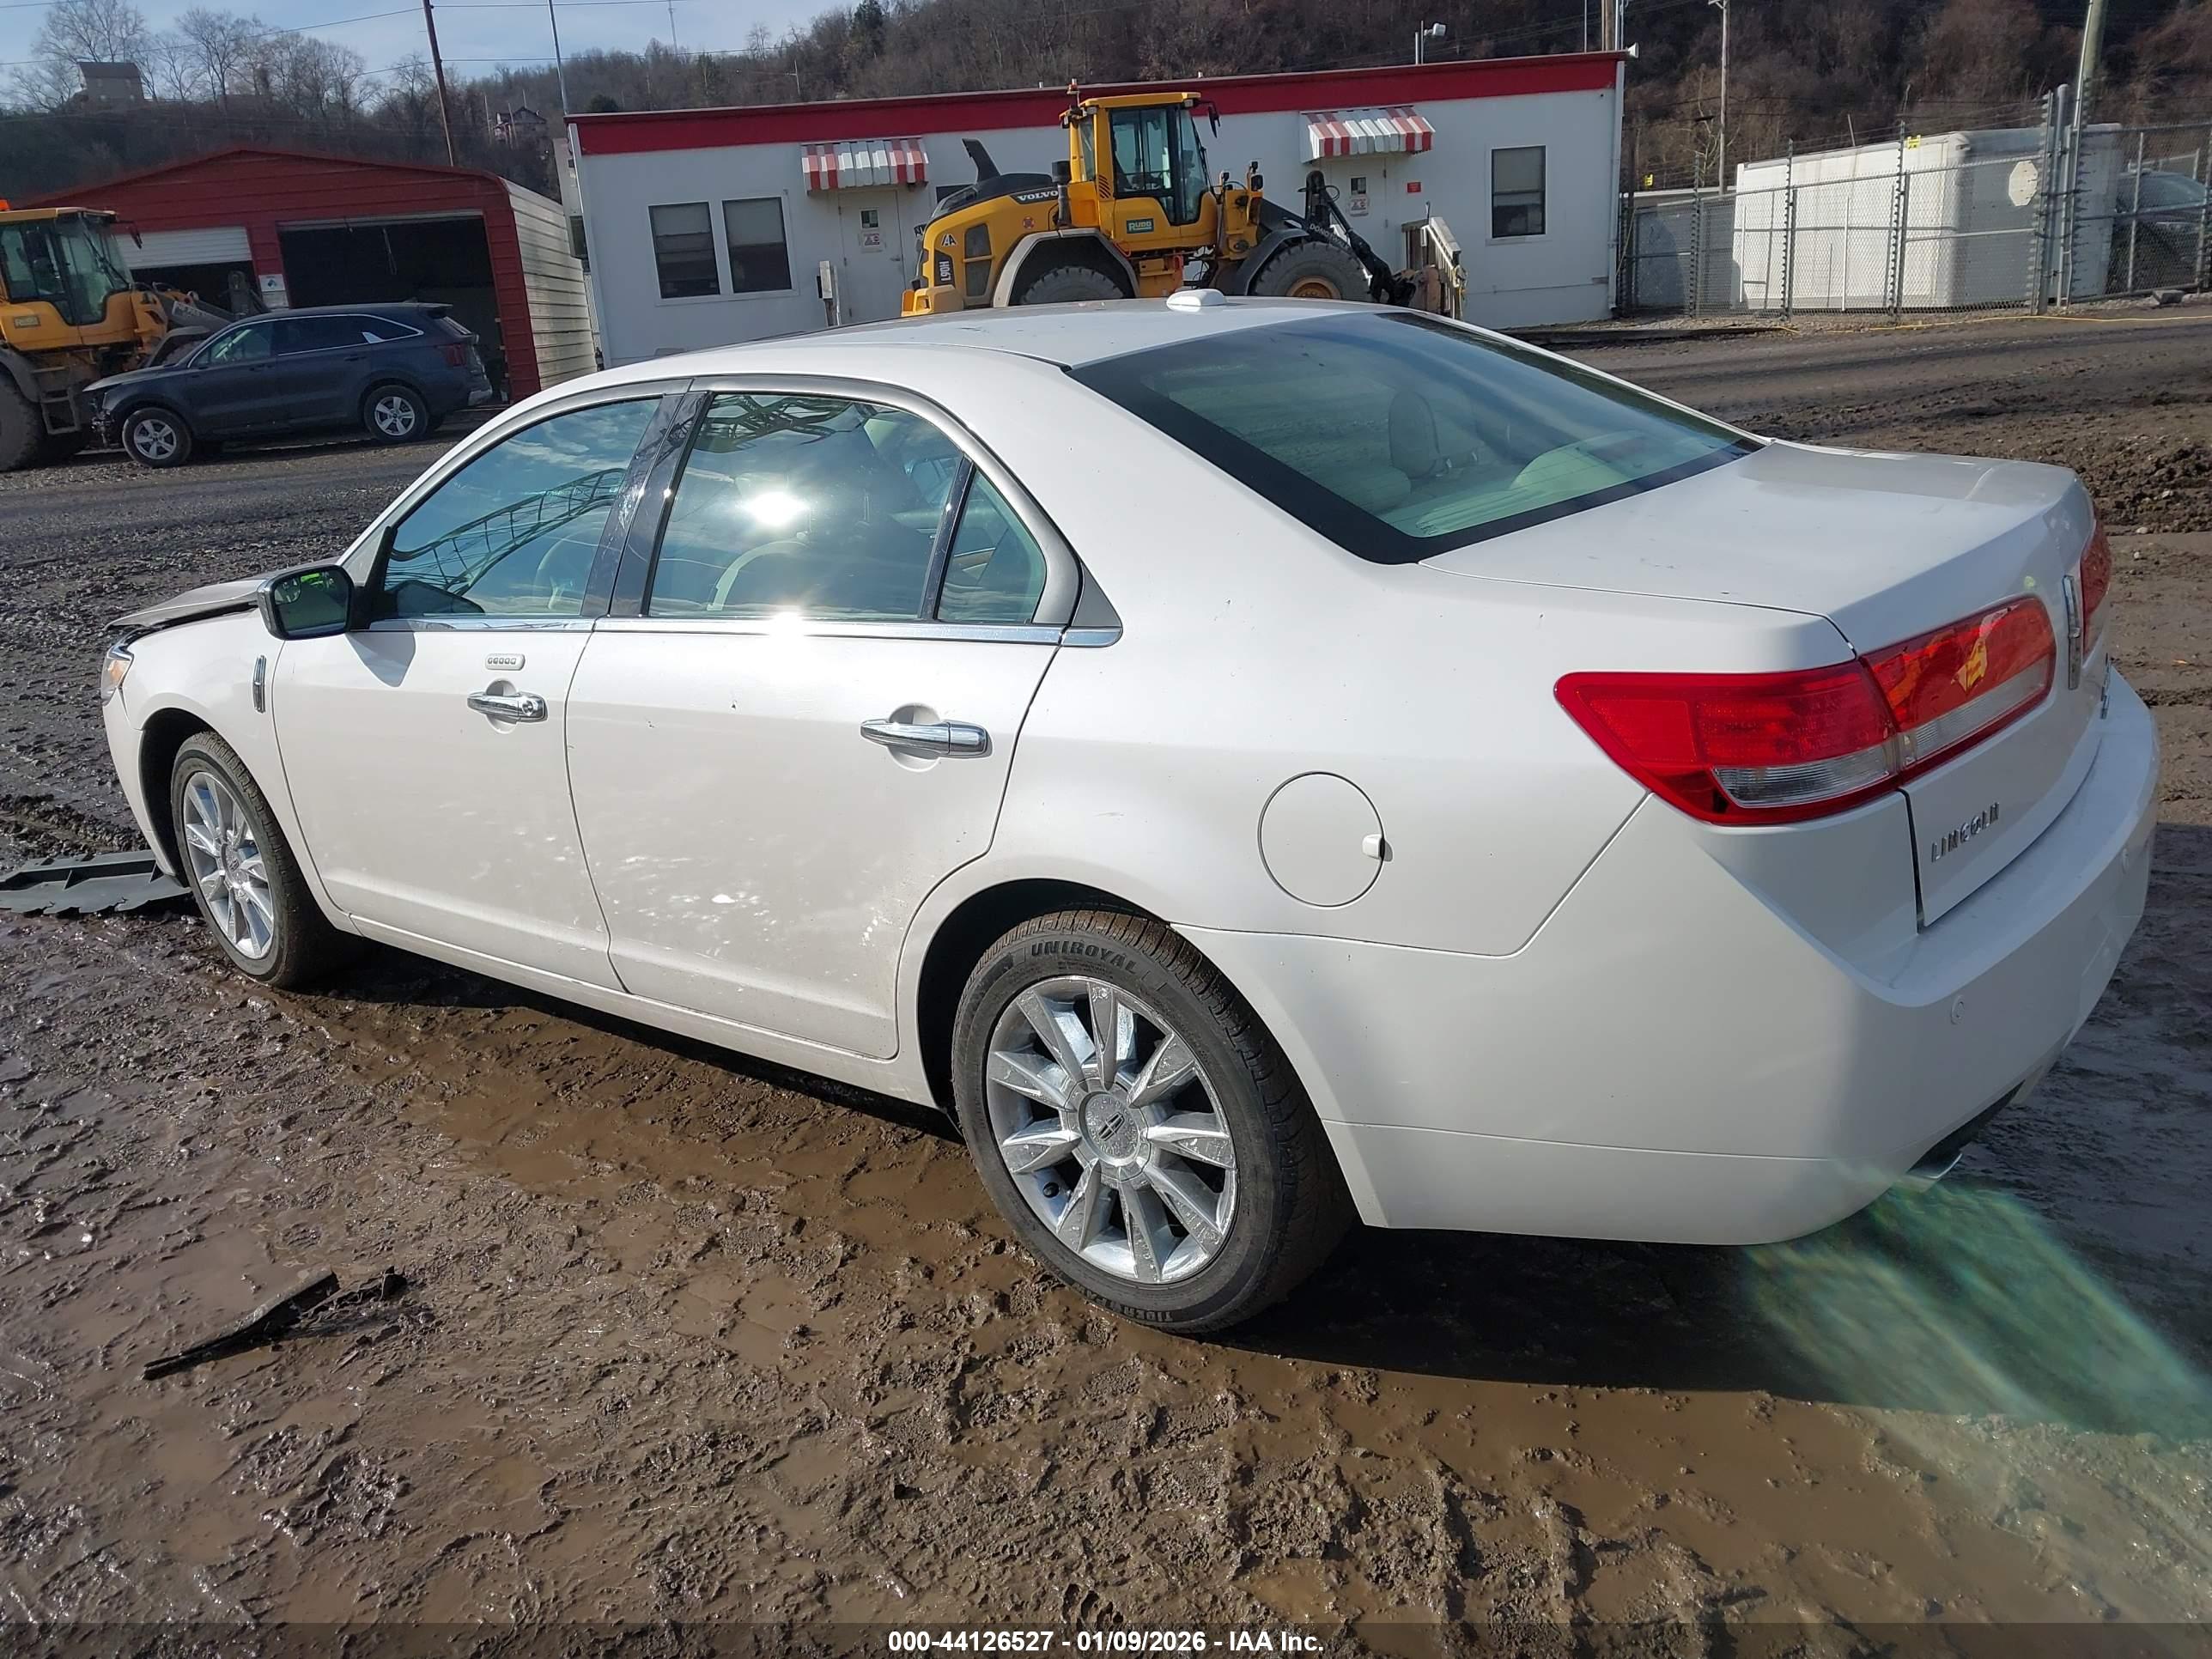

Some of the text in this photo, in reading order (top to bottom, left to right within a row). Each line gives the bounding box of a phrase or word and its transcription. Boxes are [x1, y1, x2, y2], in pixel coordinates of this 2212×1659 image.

[1017, 191, 1058, 201] VOLVO
[939, 260, 951, 282] L90H
[1931, 802, 1999, 863] LINCOLN
[1031, 939, 1139, 975] UNIROYAL
